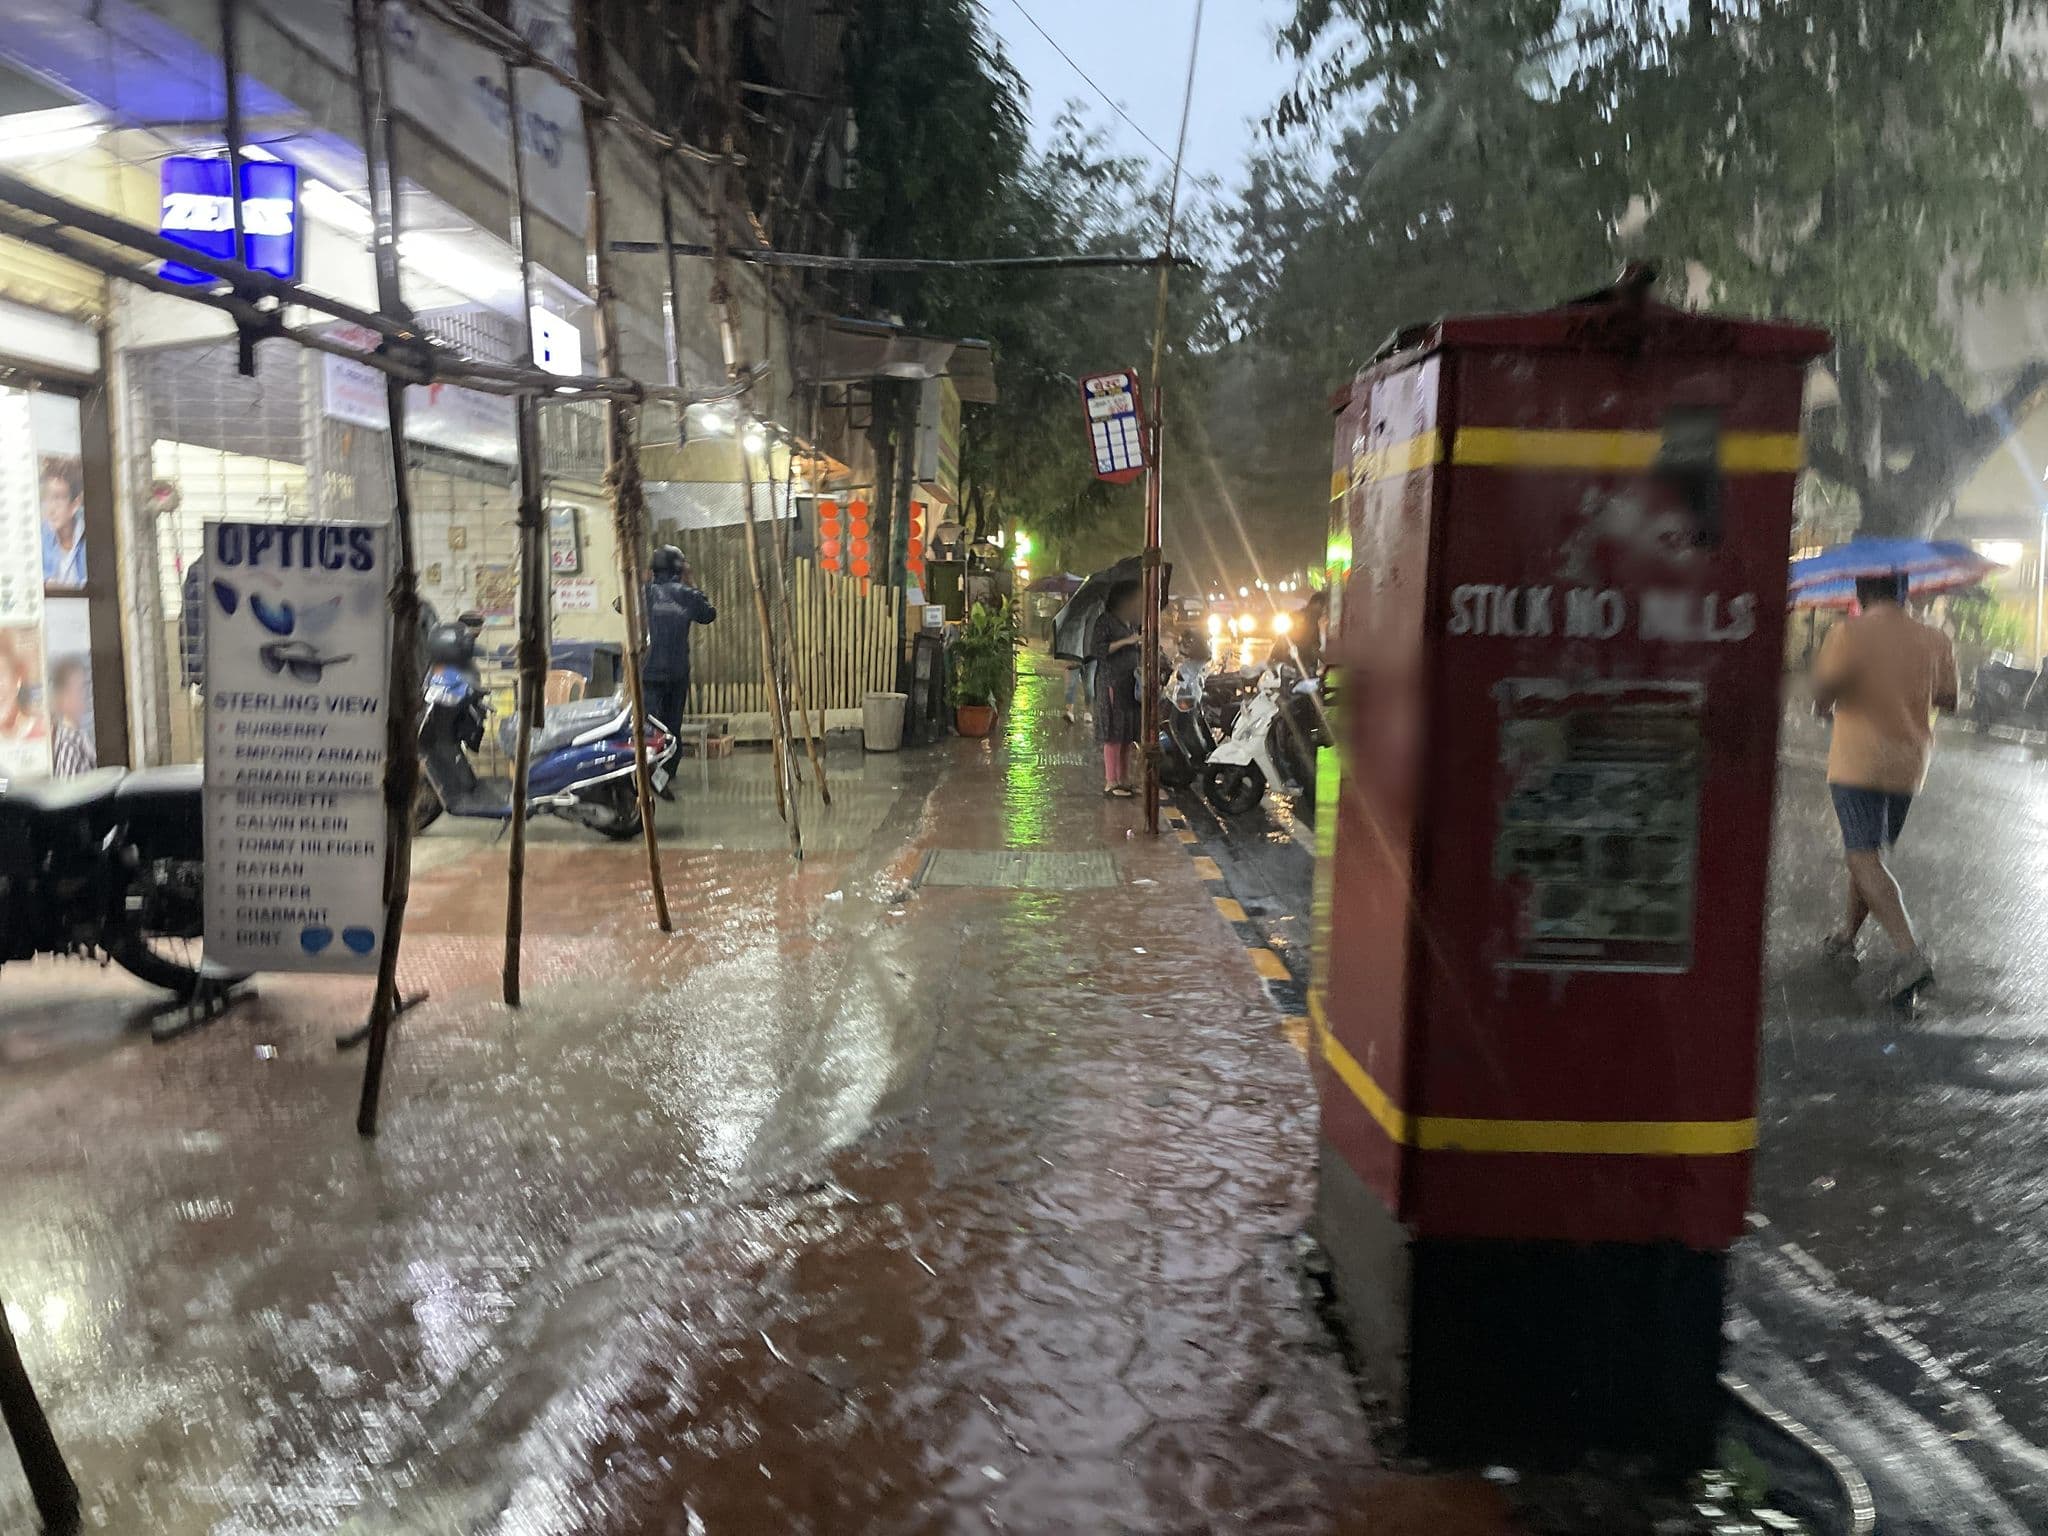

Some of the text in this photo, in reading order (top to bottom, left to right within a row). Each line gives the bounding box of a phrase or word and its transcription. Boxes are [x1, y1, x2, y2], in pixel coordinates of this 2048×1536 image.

[217, 523, 374, 571] OPTICS
[214, 692, 378, 714] STERLING VIEW
[235, 722, 327, 737] BURBERRY
[235, 746, 385, 763] EMPORIO ARMANI
[236, 769, 300, 785] ARMANI
[236, 815, 348, 833] CALVIN KLEIN
[237, 838, 375, 856] TOMMY HILFIGER
[236, 907, 328, 924] CHARMANT
